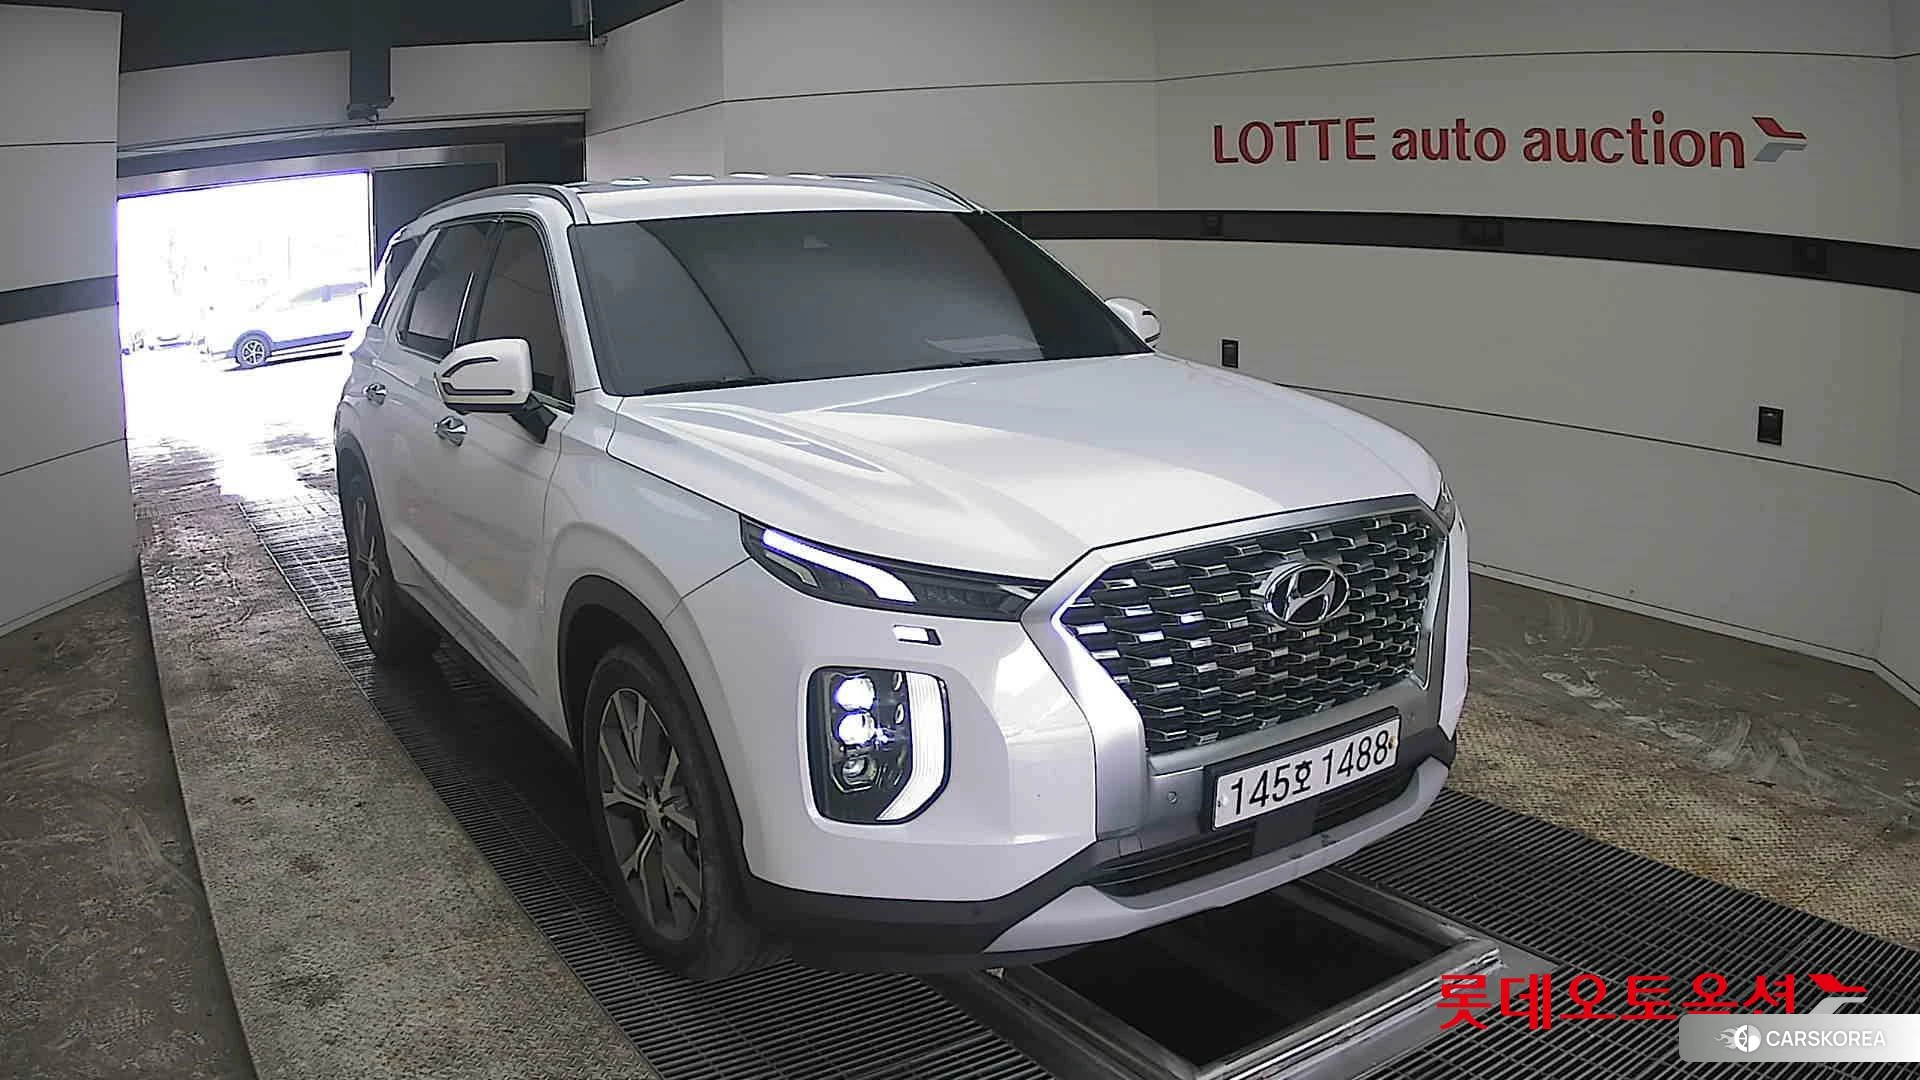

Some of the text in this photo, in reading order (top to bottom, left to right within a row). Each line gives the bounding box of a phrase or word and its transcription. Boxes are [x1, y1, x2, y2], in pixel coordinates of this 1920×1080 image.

[1213, 110, 1746, 169] LOTTE auto auction
[1231, 730, 1389, 815] 145호 1488
